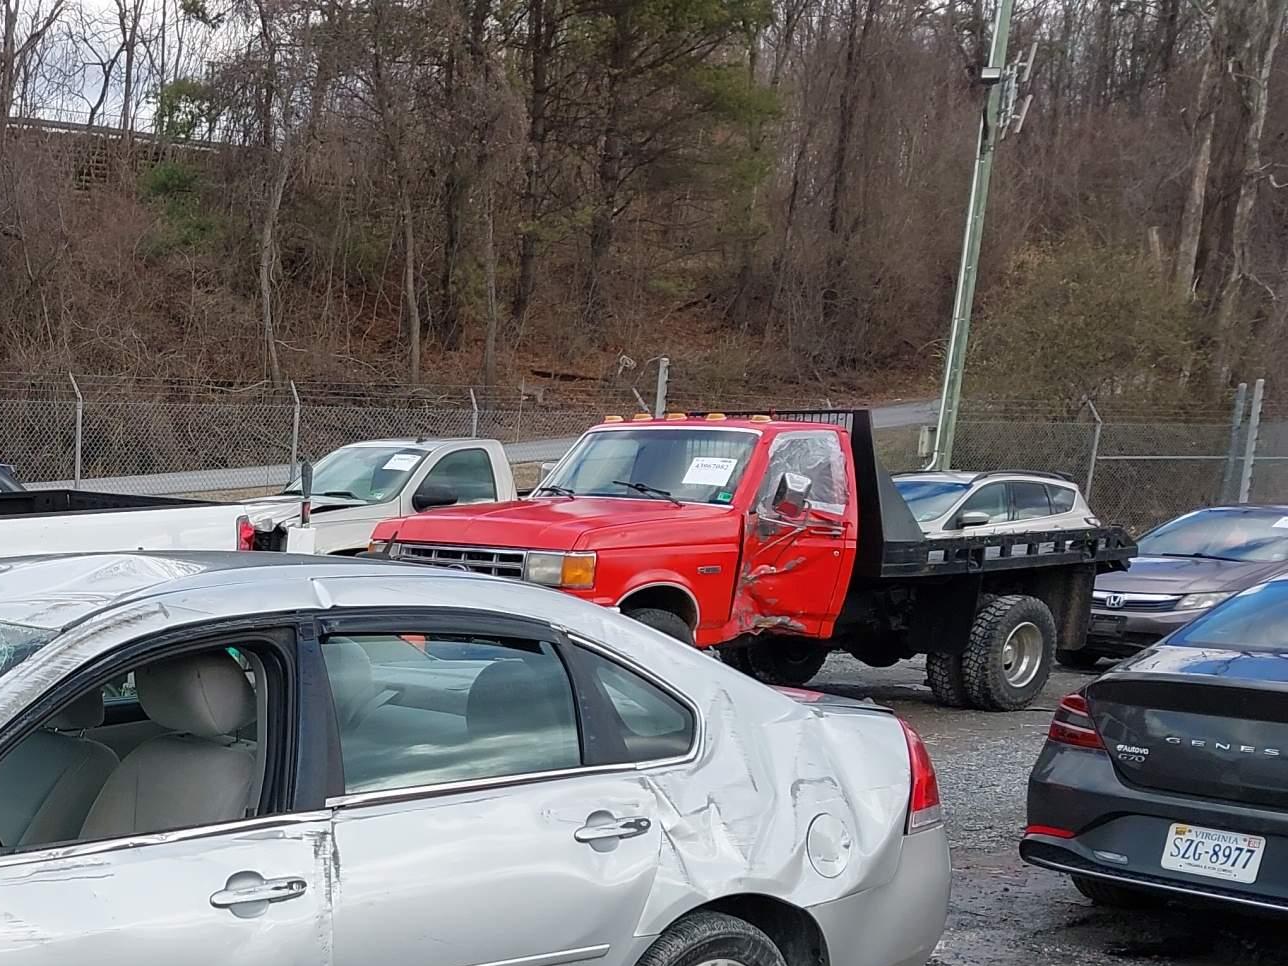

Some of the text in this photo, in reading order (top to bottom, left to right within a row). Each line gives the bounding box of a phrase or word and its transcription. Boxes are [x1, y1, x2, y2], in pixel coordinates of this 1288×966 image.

[1165, 736, 1281, 757] GENES
[1117, 753, 1146, 763] G70
[1194, 830, 1239, 845] VIRGINIA
[1169, 836, 1257, 870] SZG-8977
